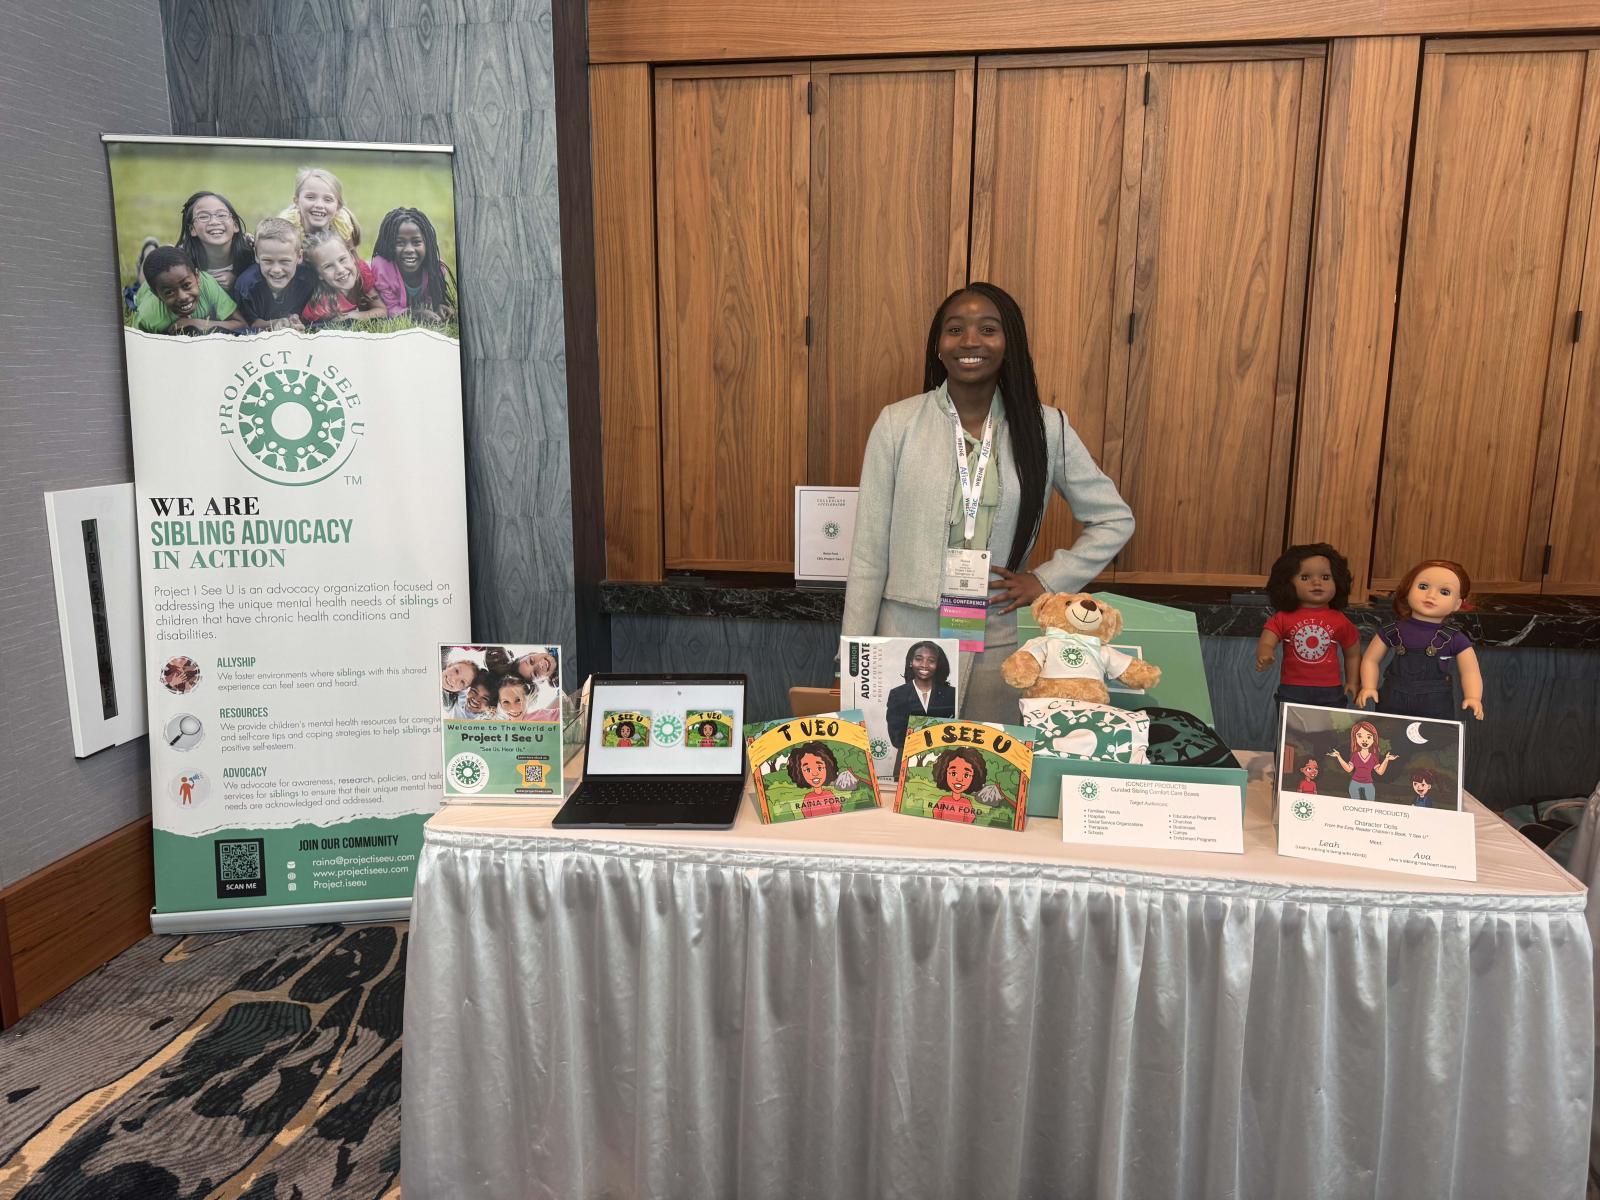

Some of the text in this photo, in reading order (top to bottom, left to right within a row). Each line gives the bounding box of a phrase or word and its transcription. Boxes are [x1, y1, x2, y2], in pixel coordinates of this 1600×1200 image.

[219, 350, 365, 436] PROJECT I SEE U
[344, 475, 362, 485] TM
[148, 496, 260, 517] WE ARE
[969, 498, 978, 519] Aflac
[151, 518, 353, 546] SIBLING ADVOCACY
[152, 548, 287, 570] IN ACTION
[154, 585, 190, 599] Project
[201, 585, 222, 596] See
[225, 584, 234, 595] U
[238, 584, 246, 595] is
[249, 586, 262, 595] an
[266, 583, 319, 599] advocacy
[323, 582, 390, 596] organization
[393, 580, 433, 592] focused
[437, 583, 450, 591] on
[155, 593, 452, 613] addressing the unique mental health needs of siblings of
[155, 608, 410, 626] children that have chronic health conditions and
[156, 629, 217, 641] disabilities.
[217, 656, 256, 668] ALLYSHIP
[217, 666, 427, 680] We foster environments where siblings with this shared
[861, 642, 870, 700] ADVOCATE
[218, 682, 260, 692] experience
[280, 680, 294, 689] feel
[317, 680, 333, 688] and
[220, 707, 268, 718] RESOURCES
[220, 722, 235, 731] We
[237, 721, 267, 732] provide
[269, 720, 306, 730] children's
[308, 719, 334, 728] mental
[336, 718, 359, 727] health
[399, 715, 410, 724] for
[777, 719, 839, 741] T VEO
[220, 733, 236, 742] and
[272, 732, 286, 742] tips
[288, 730, 304, 739] and
[306, 730, 333, 740] coping
[336, 729, 371, 739] strategies
[383, 726, 400, 736] help
[402, 725, 431, 735] siblings
[461, 733, 502, 744] Project
[505, 734, 508, 742] I
[512, 734, 532, 742] See
[924, 725, 1012, 753] I SEE U
[221, 744, 251, 754] positive
[223, 766, 267, 778] ADVOCACY
[224, 771, 427, 790] We advocate for awareness, research, policies, and
[223, 792, 254, 801] services
[256, 790, 267, 799] for
[269, 789, 299, 800] siblings
[339, 786, 352, 794] that
[354, 785, 371, 794] their
[373, 785, 399, 795] unique
[400, 782, 426, 792] mental
[224, 801, 248, 811] needs
[265, 798, 323, 809] acknowledged
[324, 797, 340, 806] and
[342, 794, 384, 805] addressed.
[795, 796, 846, 810] RAINA FORD
[927, 801, 983, 816] RAINA FORD
[1354, 819, 1382, 828] Character
[298, 835, 399, 852] JOIN OUR COMMUNITY
[1319, 840, 1431, 860] Leah Ava
[312, 853, 415, 868] raina@projectiseeu.com
[313, 866, 409, 879] www.projectiseeu.com
[226, 883, 244, 891] SCAN
[313, 880, 367, 891] Project.iseeu
